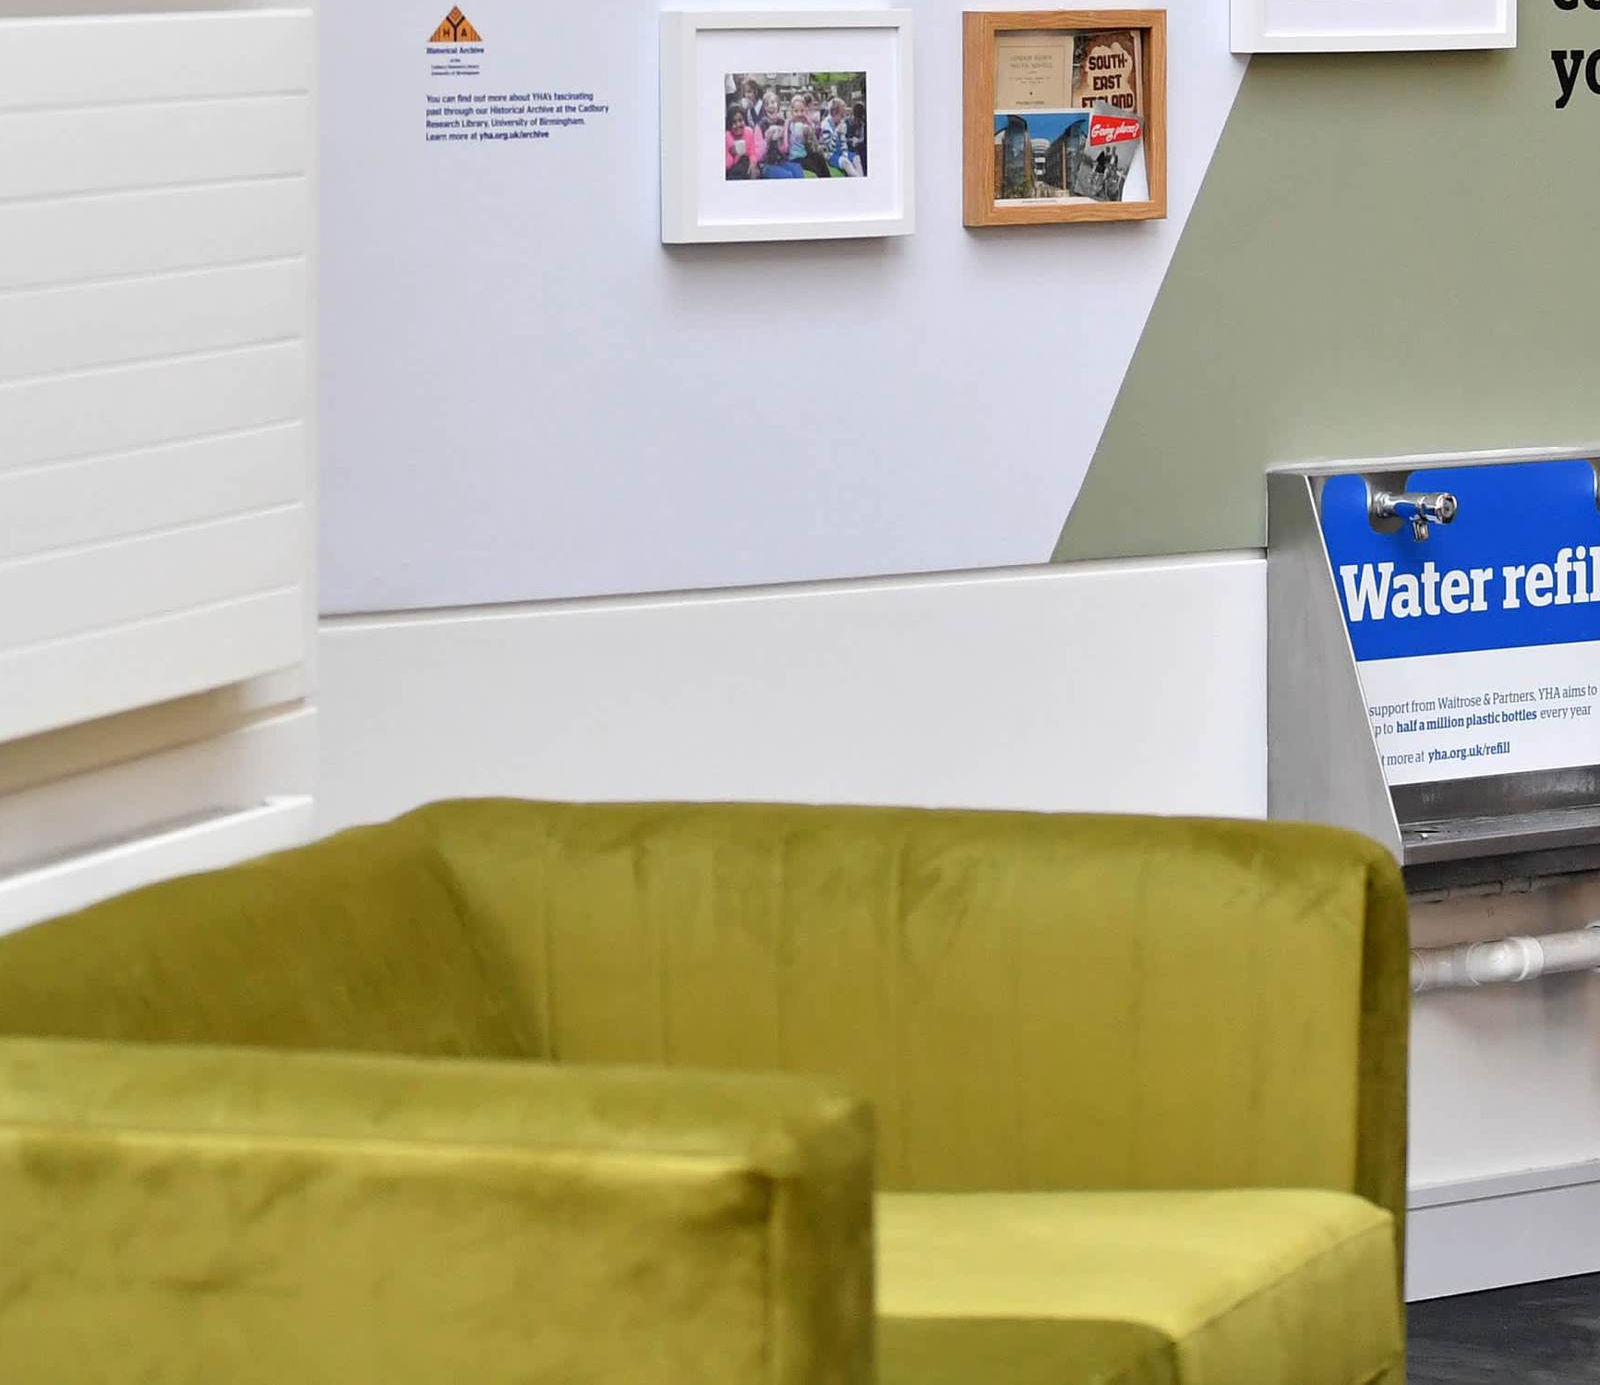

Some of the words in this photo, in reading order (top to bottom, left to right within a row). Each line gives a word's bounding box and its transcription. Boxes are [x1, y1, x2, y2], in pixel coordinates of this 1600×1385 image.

[459, 47, 484, 55] Archive
[1088, 53, 1128, 71] SOUTH-
[1093, 75, 1122, 91] EAST
[426, 95, 440, 103] You
[457, 94, 471, 103] find
[509, 93, 530, 102] about
[531, 92, 552, 101] YHA's
[553, 91, 593, 102] fascinating
[426, 108, 441, 117] past
[443, 107, 474, 117] through
[490, 105, 525, 114] Historical
[527, 104, 554, 113] Archive
[555, 104, 563, 113] at
[564, 104, 577, 112] the
[578, 103, 609, 113] Cadbury
[426, 119, 460, 128] Research
[491, 117, 528, 127] University
[529, 117, 537, 126] of
[425, 132, 447, 141] Learn
[470, 132, 478, 140] at
[480, 130, 549, 141] yha.org.uk/archive
[1340, 562, 1493, 622] Water
[1368, 701, 1409, 719] support
[1411, 699, 1436, 713] from
[1437, 695, 1481, 710] Waitrose
[1483, 693, 1491, 705] &
[1492, 689, 1536, 706] Partners,
[1538, 686, 1561, 700] YHA
[1562, 685, 1586, 698] aims
[1587, 685, 1598, 697] to
[1383, 723, 1394, 735] to
[1396, 720, 1418, 734] half
[1419, 721, 1426, 731] a
[1426, 716, 1465, 731] million
[1466, 711, 1502, 729] plastic
[1502, 708, 1538, 723] bottles
[1540, 706, 1569, 720] every
[1570, 704, 1592, 718] year
[1387, 754, 1415, 766] more
[1415, 750, 1426, 763] at
[1428, 741, 1511, 763] yha.org.uk/refill
